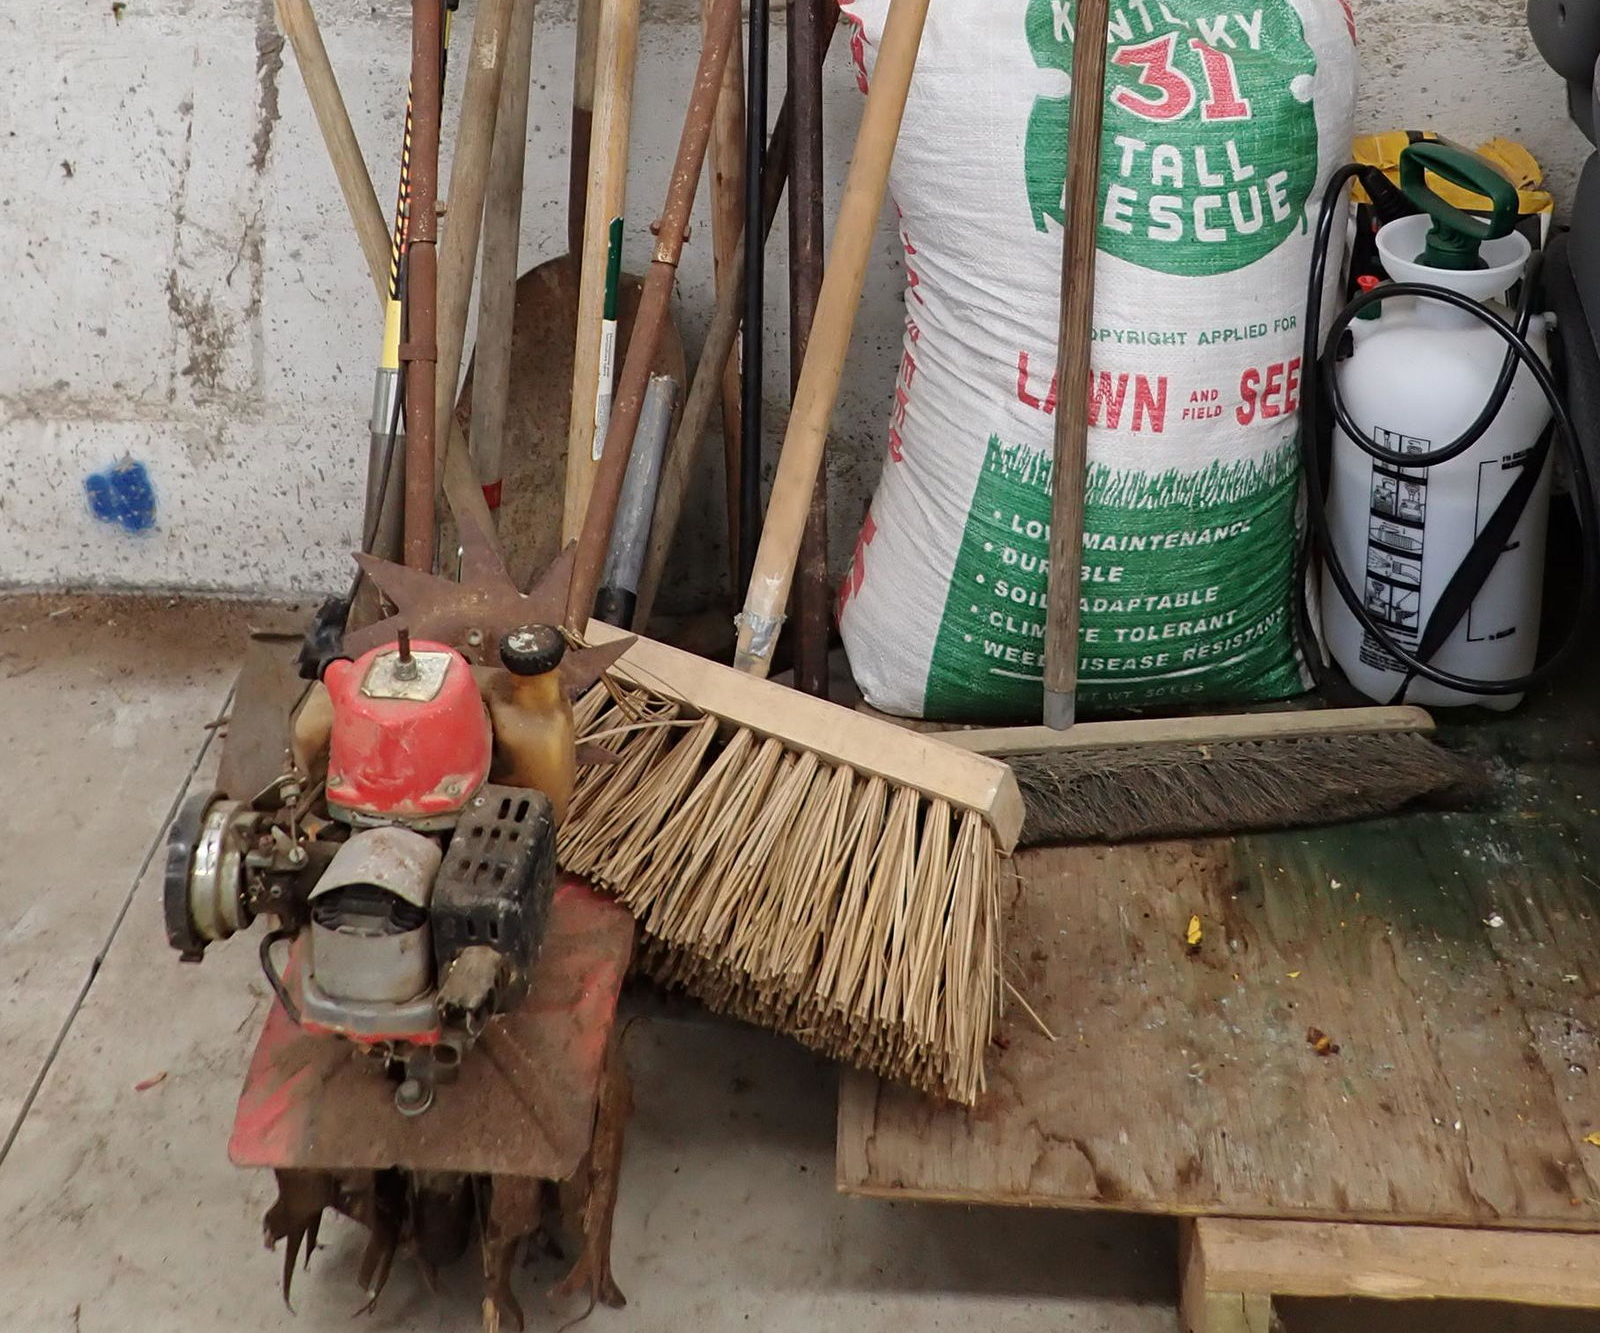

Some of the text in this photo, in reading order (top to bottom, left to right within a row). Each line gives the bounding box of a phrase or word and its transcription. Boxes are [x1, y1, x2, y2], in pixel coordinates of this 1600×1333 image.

[1110, 31, 1252, 122] 31
[1114, 135, 1255, 188] TALL
[1060, 170, 1291, 242] ESCUE
[1091, 316, 1297, 346] OPYRIGHT APPLIED FOR
[1189, 389, 1219, 403] AND
[1236, 356, 1302, 427] SEE
[1182, 405, 1222, 420] FIELD
[1002, 546, 1125, 583] DURBLE
[994, 580, 1219, 612] SOIL ADAPTABLE
[989, 609, 1237, 643] CLIME TOLERANT
[1080, 653, 1169, 671] ISEASE
